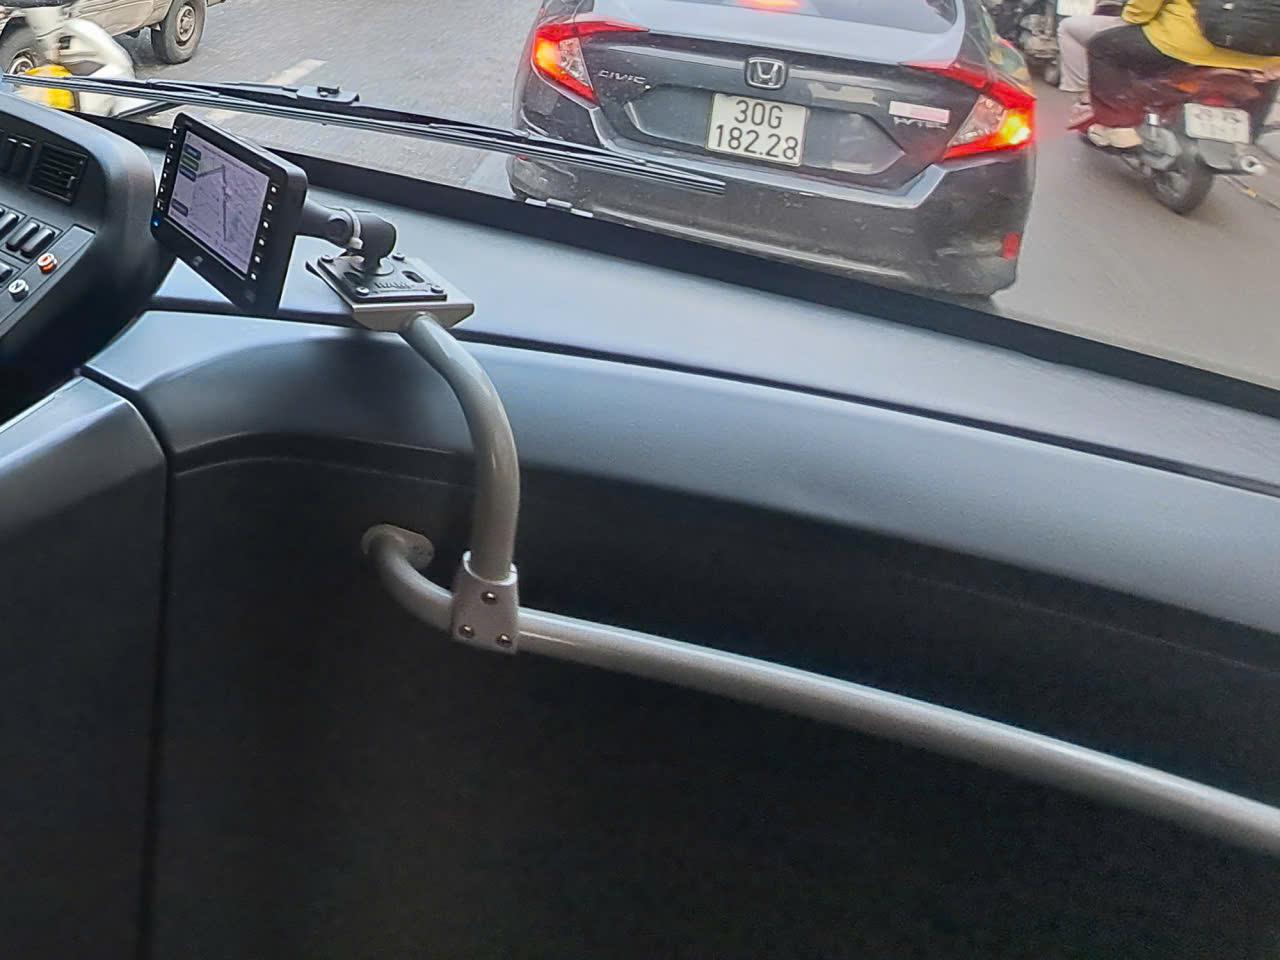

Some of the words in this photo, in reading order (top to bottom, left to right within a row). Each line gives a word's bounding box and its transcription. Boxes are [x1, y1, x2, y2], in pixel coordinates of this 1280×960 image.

[599, 70, 646, 84] CIVIC
[734, 100, 783, 129] 30G
[716, 124, 798, 160] 182.28
